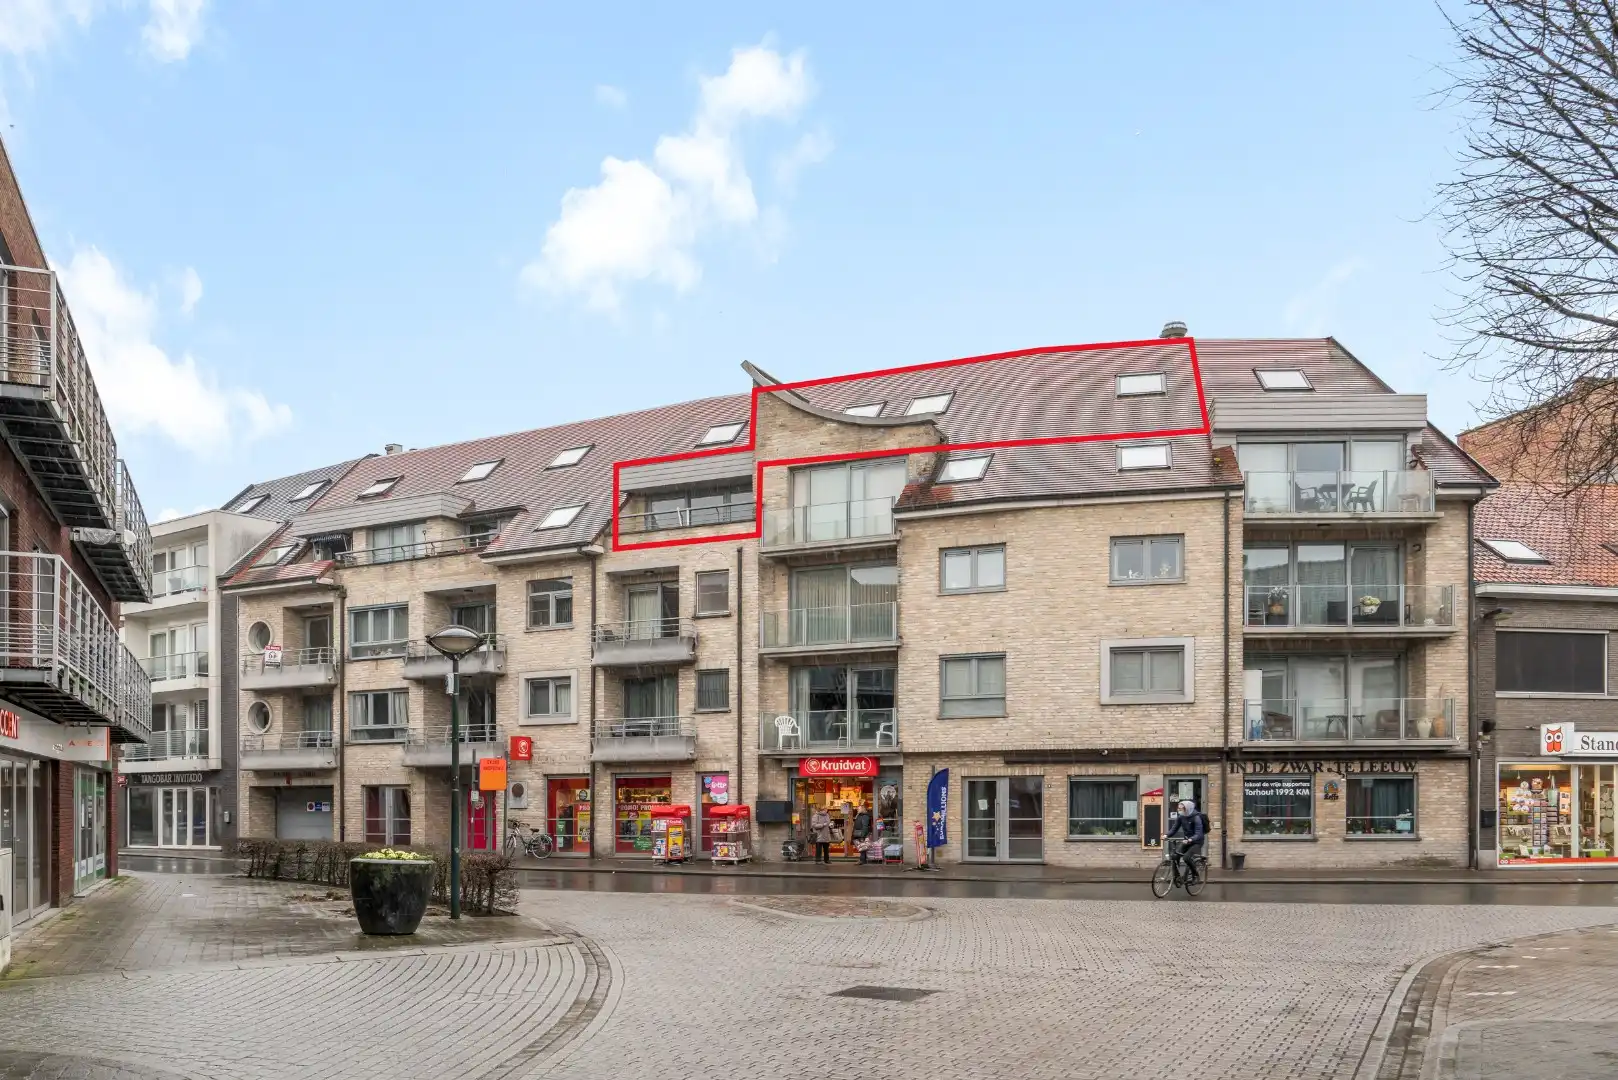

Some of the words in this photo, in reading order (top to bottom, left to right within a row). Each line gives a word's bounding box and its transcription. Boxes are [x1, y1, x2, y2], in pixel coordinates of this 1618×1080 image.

[821, 760, 866, 771] Kruidvat
[1230, 762, 1246, 774] IN
[1253, 762, 1273, 773] DE
[1360, 761, 1418, 773] LEEUW
[141, 774, 172, 784] TANGOBAR
[173, 773, 202, 783] INVITADO
